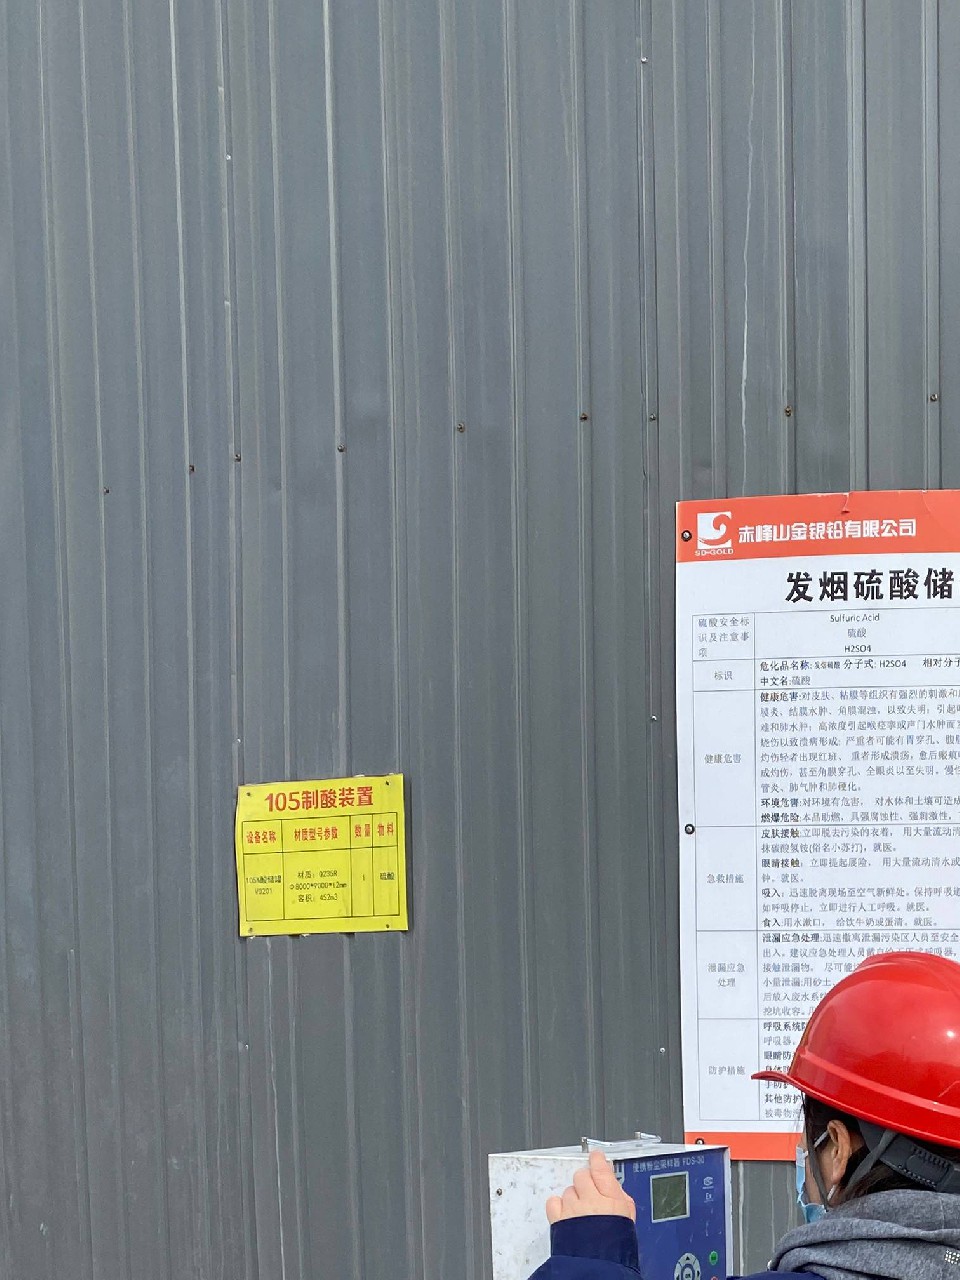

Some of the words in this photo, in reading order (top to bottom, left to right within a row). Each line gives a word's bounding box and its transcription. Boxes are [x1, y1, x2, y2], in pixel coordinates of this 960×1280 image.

[739, 518, 917, 544] 赤峰山金银铅有限公司
[694, 548, 734, 556] SD-GOLD
[698, 617, 750, 628] 硫酸安全标
[830, 614, 860, 623] Sulfuric
[862, 613, 880, 622] Acid
[698, 631, 749, 643] 识及注意事
[847, 628, 866, 638] 硫酸
[844, 645, 871, 653] H2SO4
[714, 670, 733, 681] 标识
[704, 754, 742, 764] 健康危害
[264, 786, 374, 812] 105制酸装置
[294, 827, 338, 842] 材质型号参数
[354, 824, 371, 838] 数量
[377, 823, 394, 837] 物料
[246, 831, 277, 844] 设备名称
[707, 874, 744, 884] 急救措施
[708, 962, 745, 973] 泄漏应急
[717, 977, 736, 987] 处理
[708, 1065, 745, 1075] 防护措施
